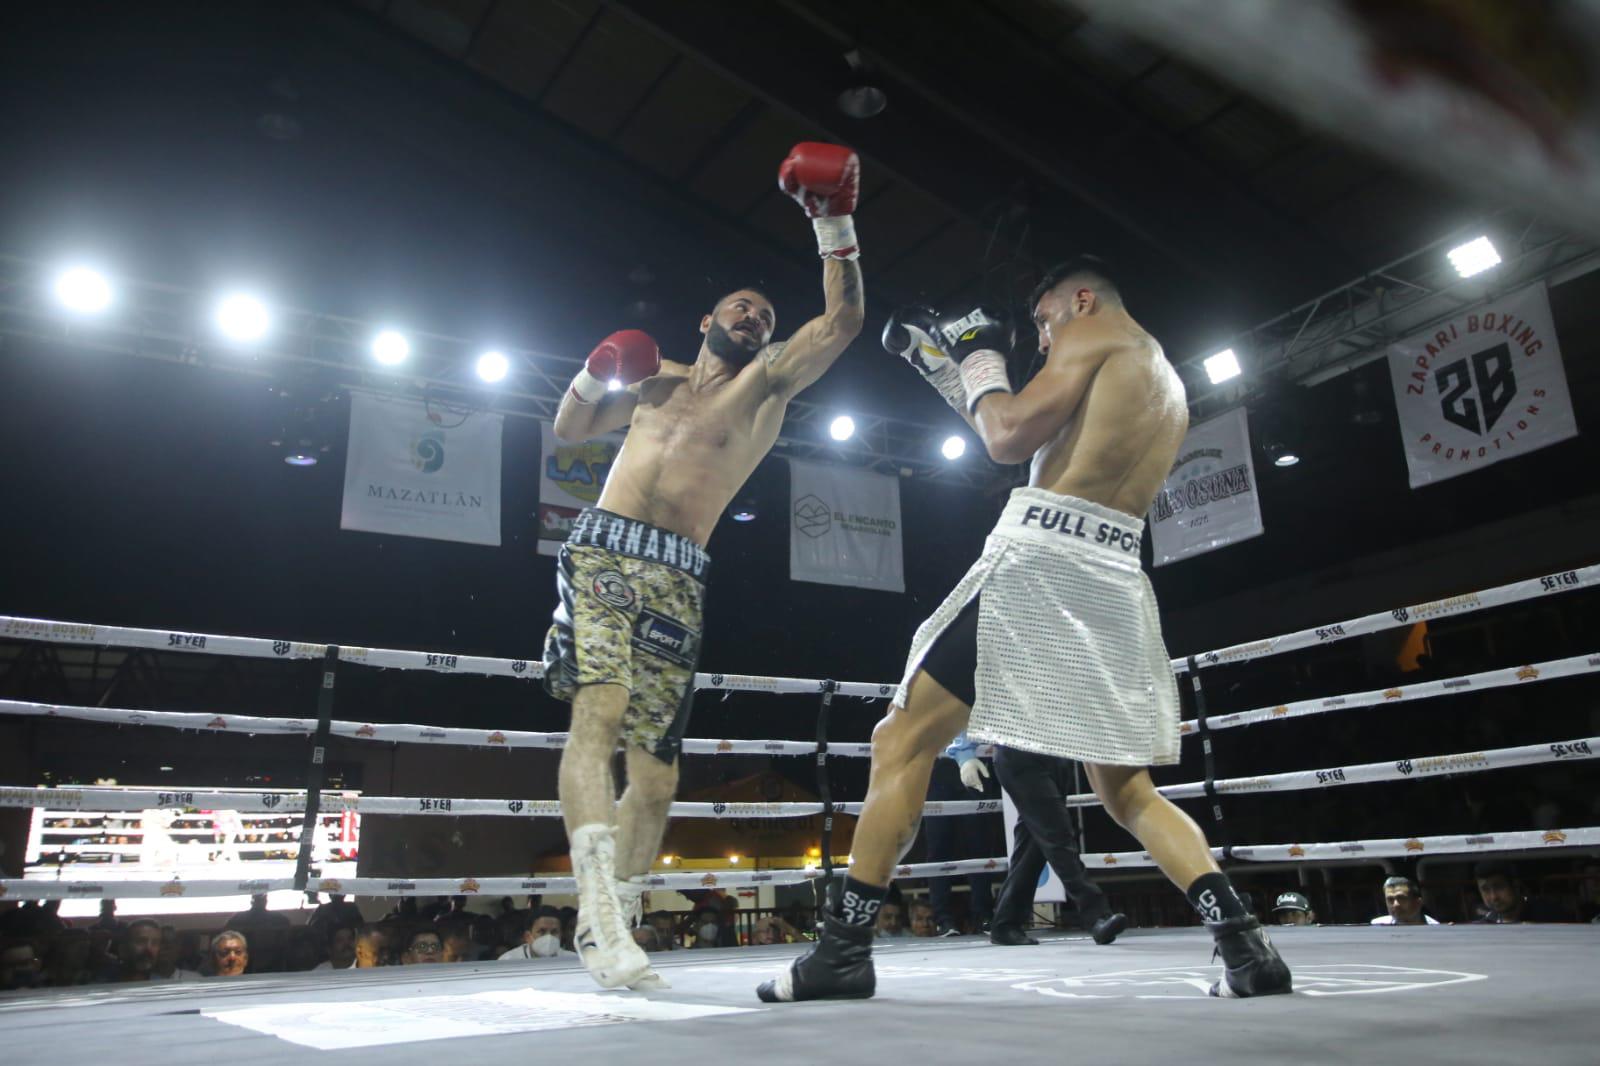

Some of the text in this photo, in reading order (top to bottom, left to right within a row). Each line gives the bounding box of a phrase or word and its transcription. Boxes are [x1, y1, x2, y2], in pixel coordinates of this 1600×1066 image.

[1407, 312, 1543, 395] ZAPARI BOXING
[1420, 388, 1546, 461] PROMOTIONS
[848, 514, 896, 530] ENCANTO
[1021, 505, 1087, 538] FULL
[1540, 571, 1579, 591] SEYER
[648, 629, 682, 649] SPORT
[1315, 625, 1345, 640] SEYER
[168, 633, 206, 649] SEYER
[425, 654, 457, 669] SEYER
[1550, 741, 1592, 758] SEYER
[1315, 768, 1346, 784] SEYER
[157, 793, 193, 806] SEYER
[420, 799, 452, 811] SEYER
